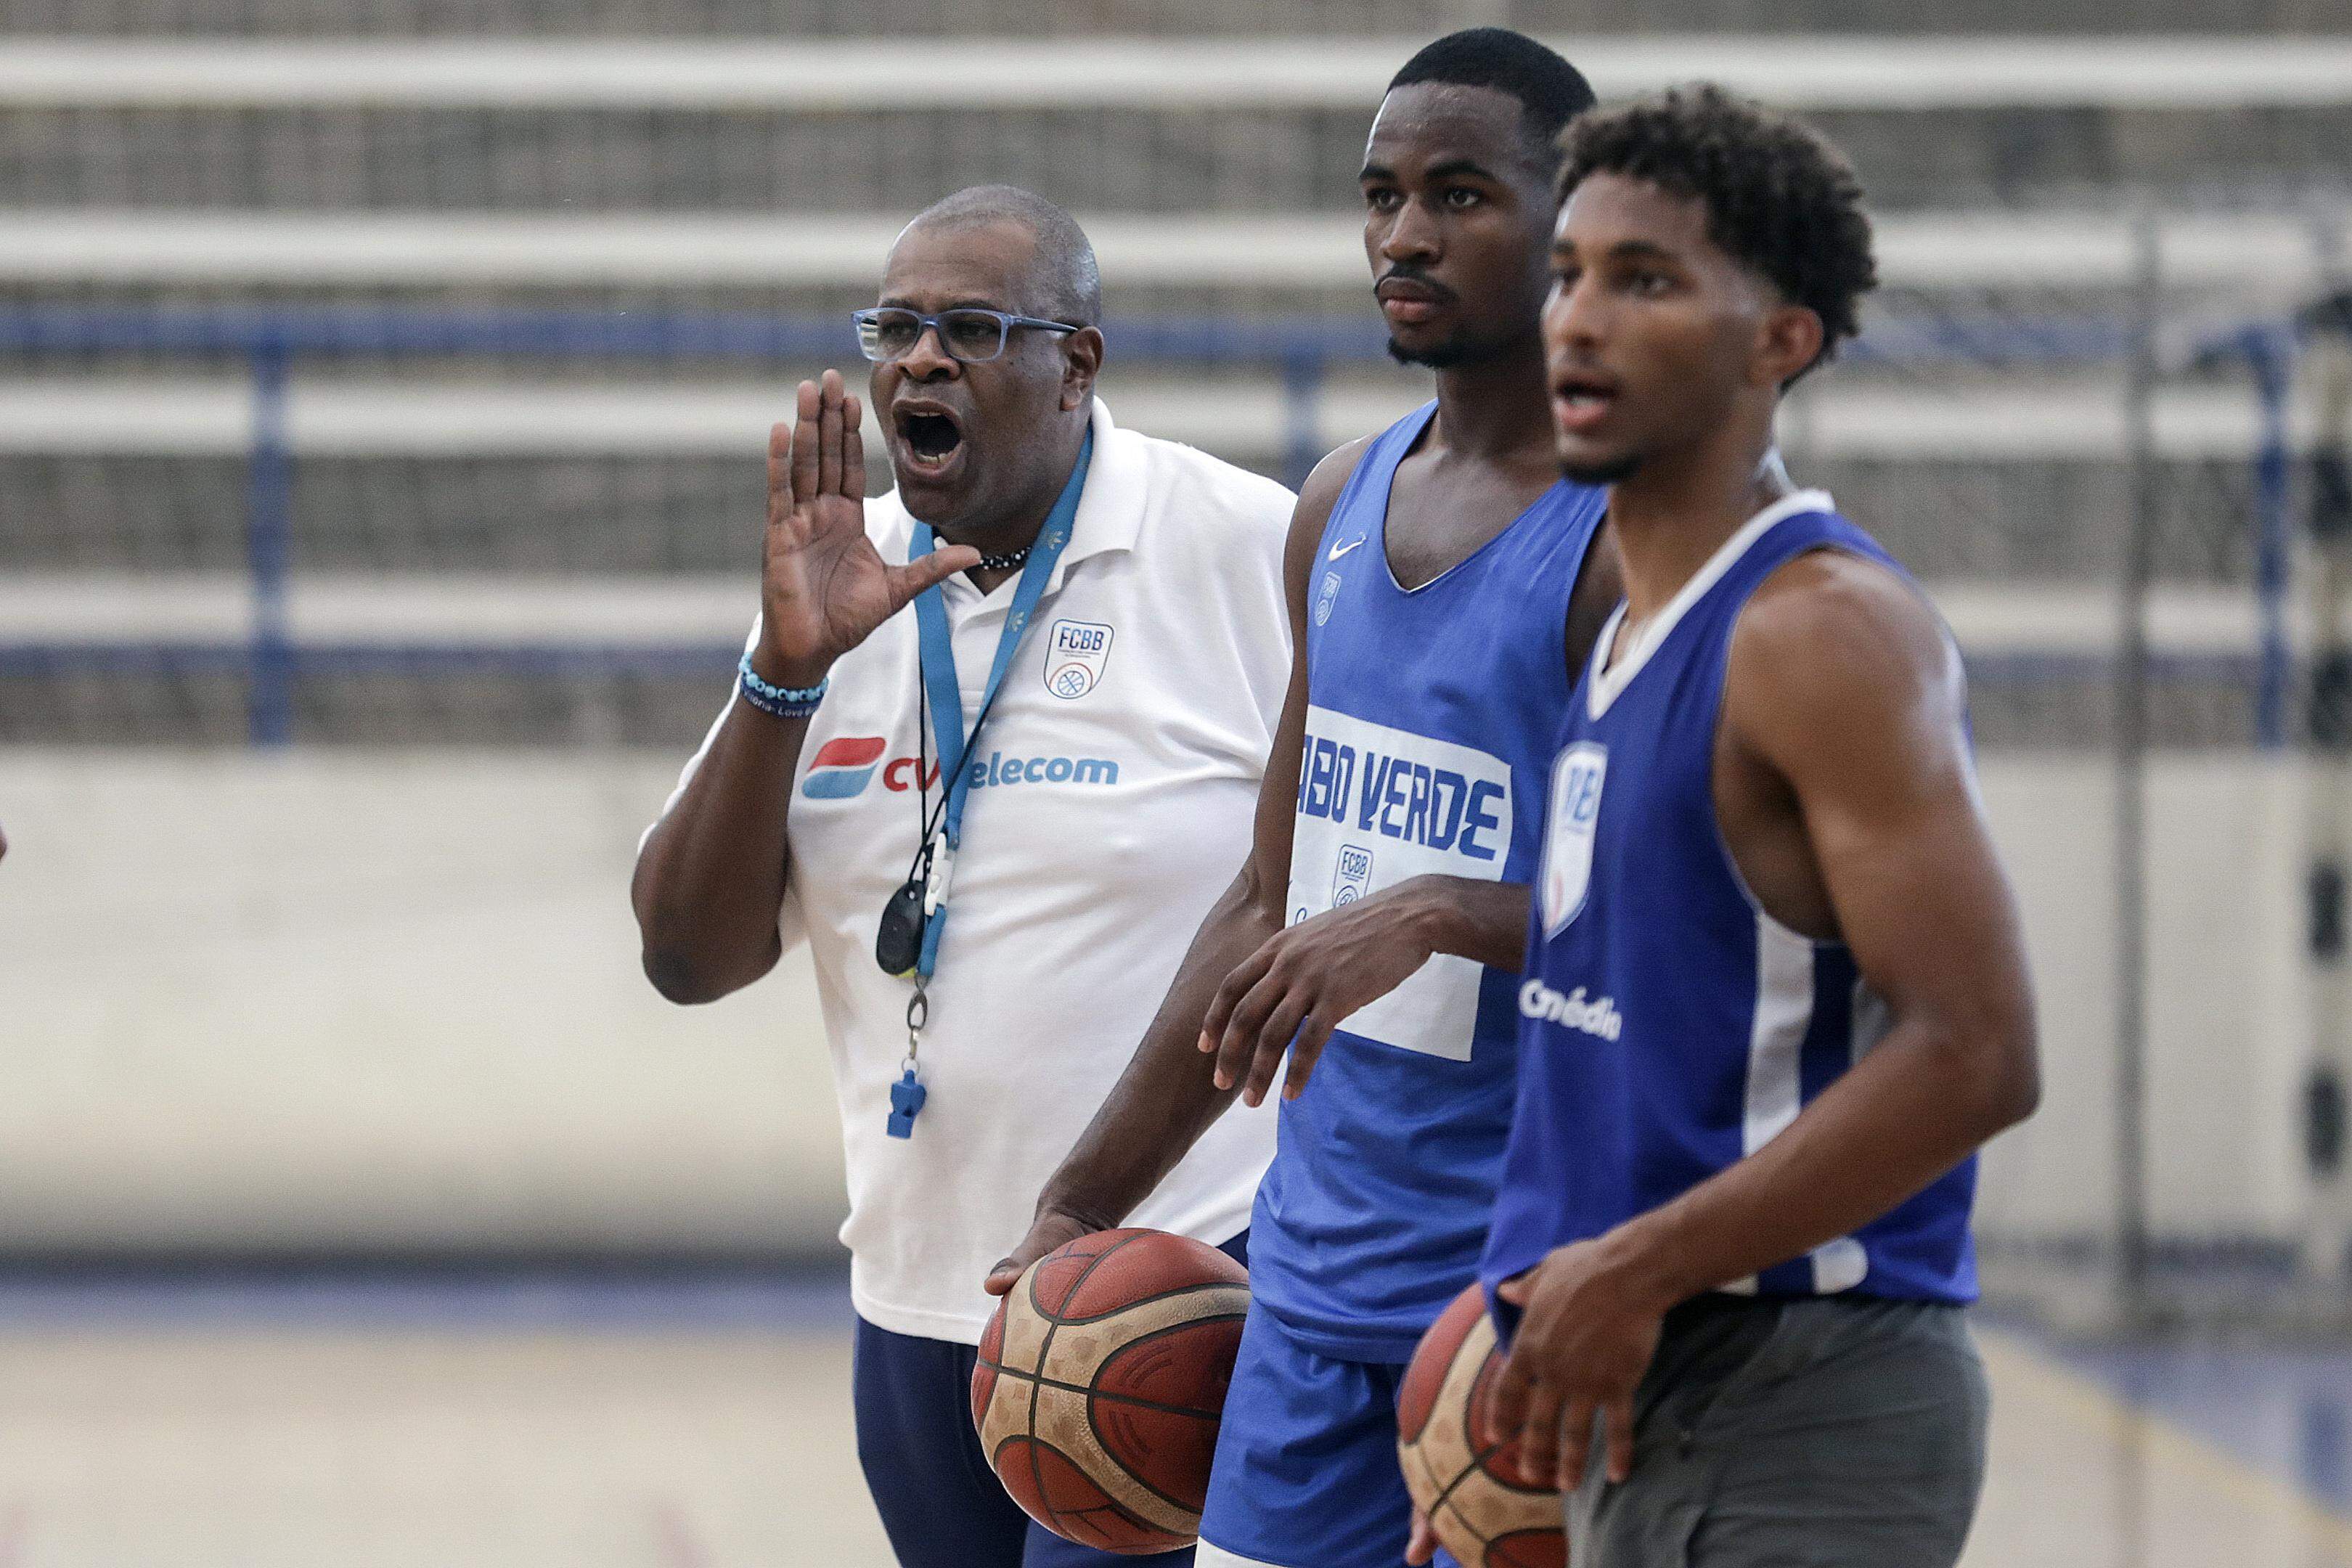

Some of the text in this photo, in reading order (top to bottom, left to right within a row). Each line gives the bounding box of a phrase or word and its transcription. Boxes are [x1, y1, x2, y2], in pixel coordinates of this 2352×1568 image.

[1058, 626, 1105, 651] FCBB
[1357, 751, 1506, 862] VERDE
[1341, 851, 1368, 875] FCBB
